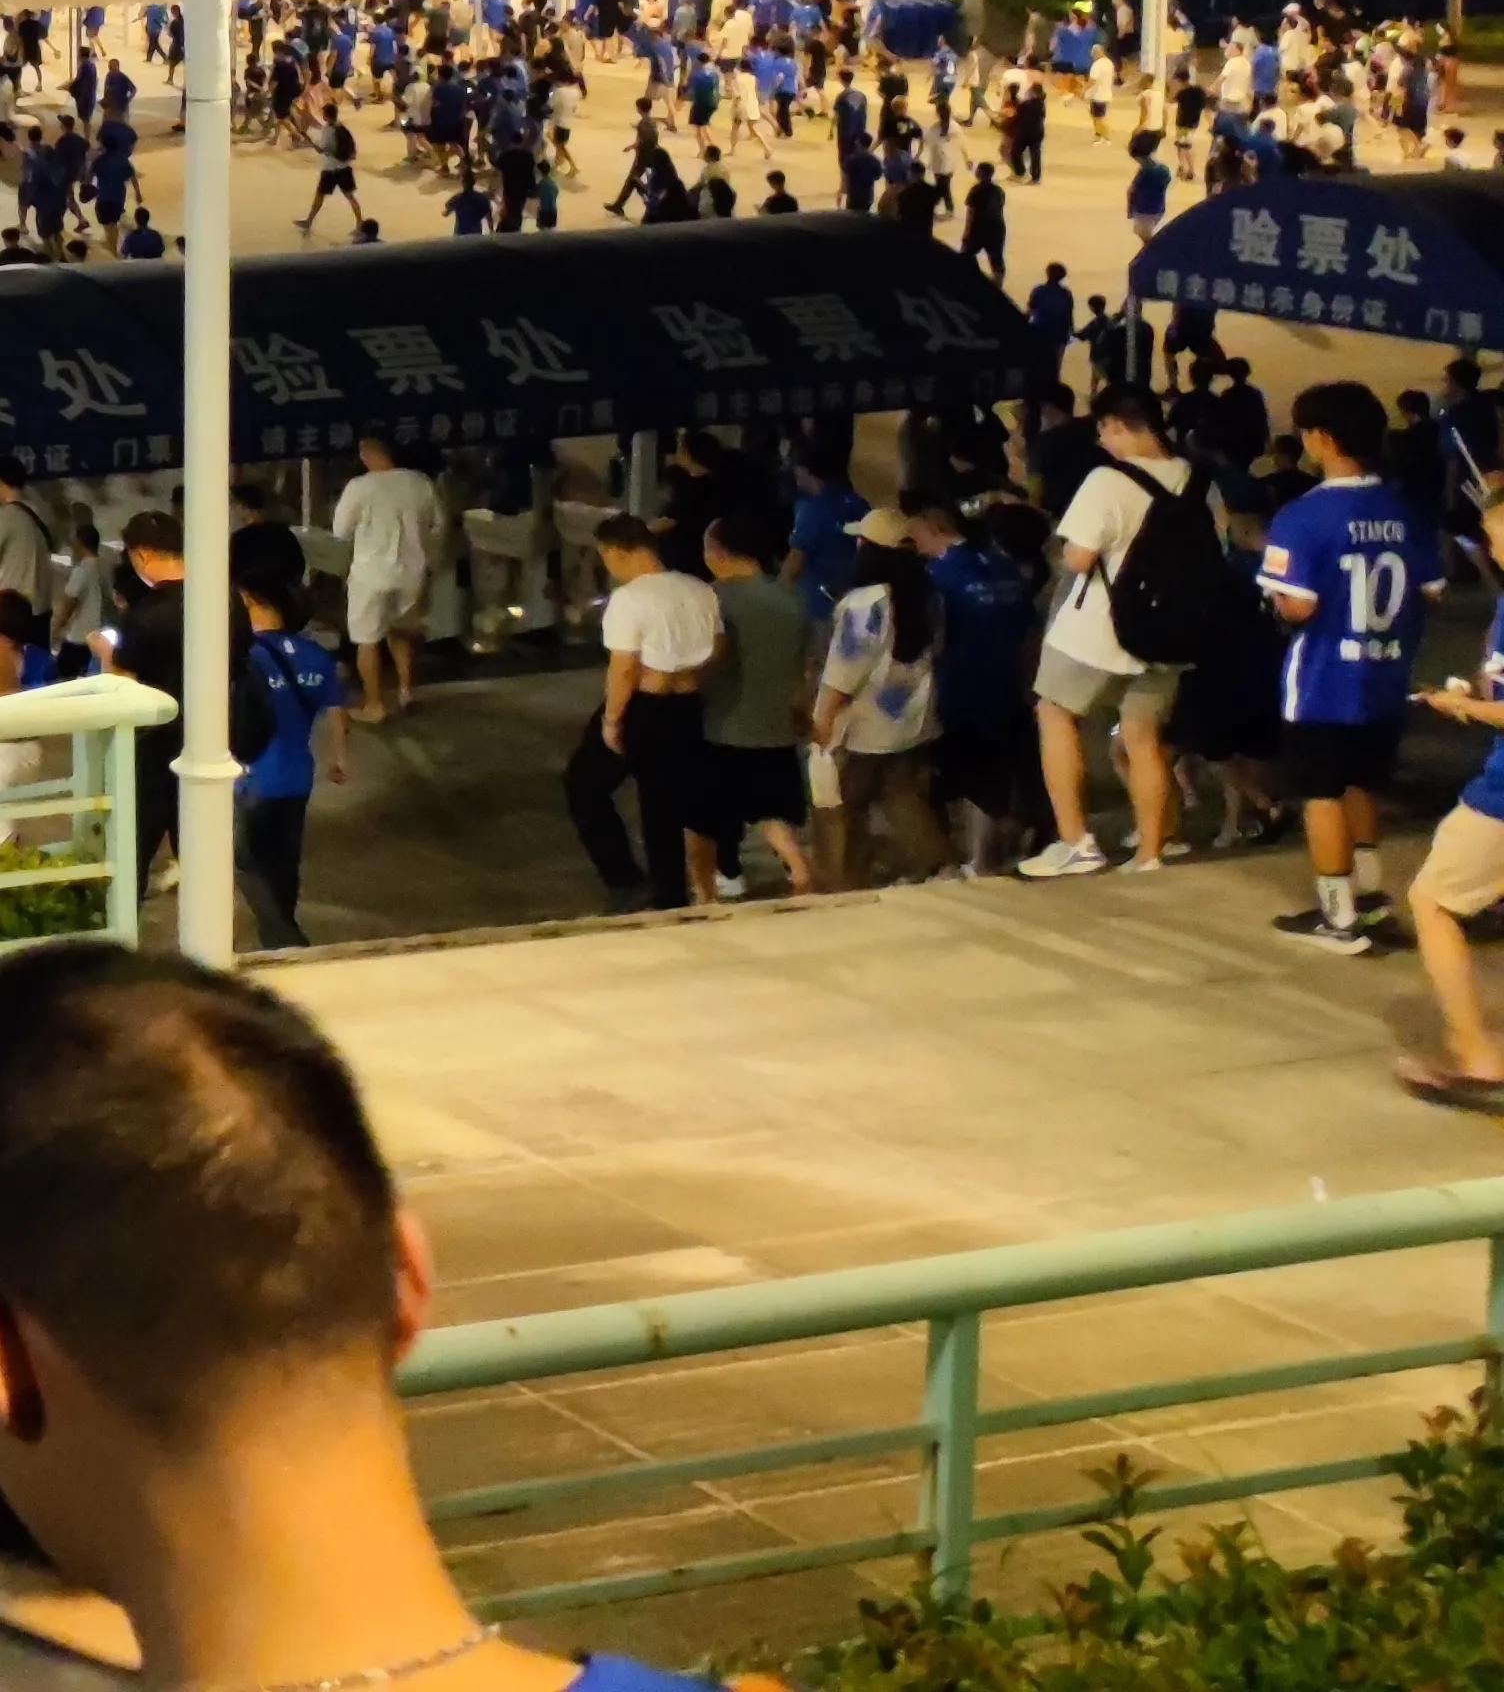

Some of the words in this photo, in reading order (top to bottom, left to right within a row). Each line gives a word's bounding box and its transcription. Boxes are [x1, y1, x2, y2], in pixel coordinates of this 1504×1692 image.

[1229, 207, 1422, 286] 验票处
[231, 315, 590, 406] 验票处
[649, 285, 1001, 371] 验票处
[1339, 551, 1406, 634] 10
